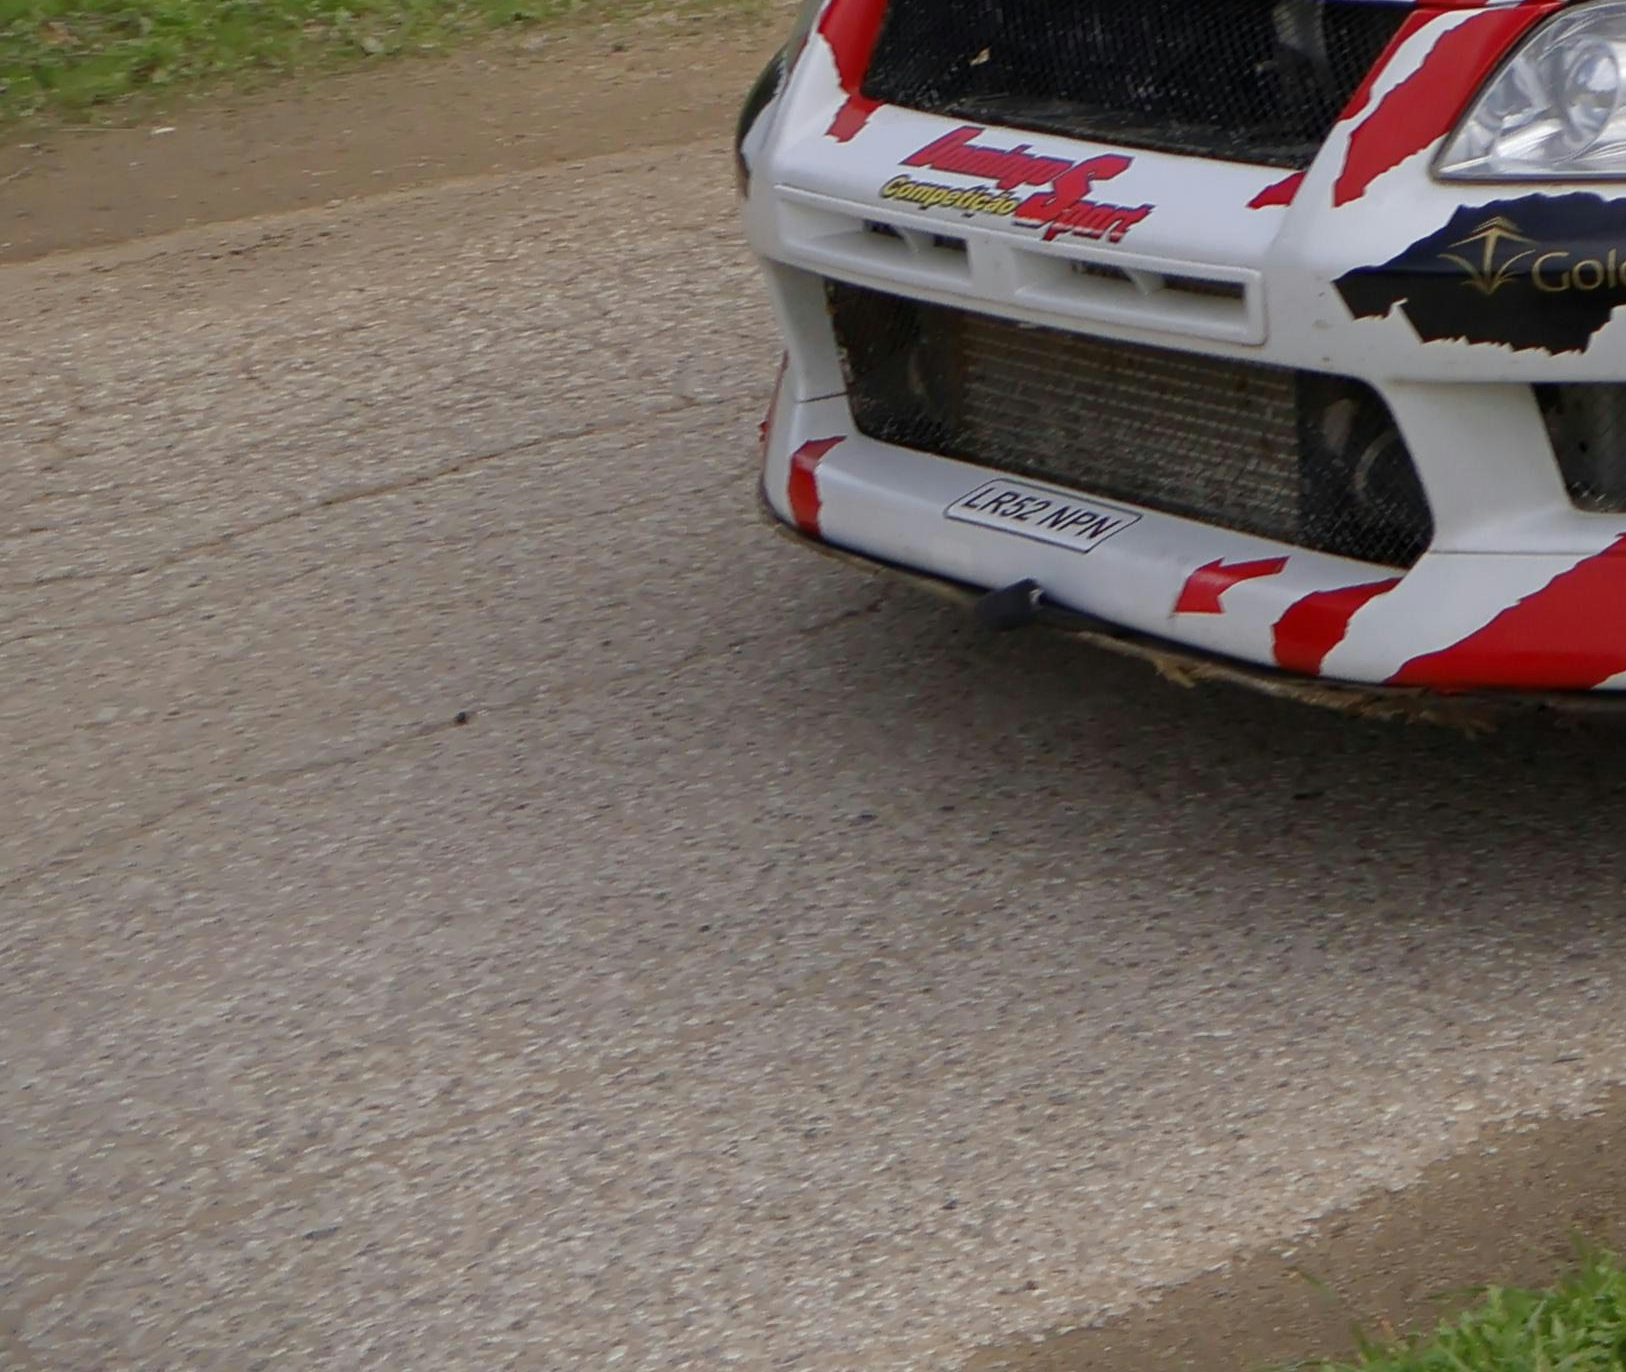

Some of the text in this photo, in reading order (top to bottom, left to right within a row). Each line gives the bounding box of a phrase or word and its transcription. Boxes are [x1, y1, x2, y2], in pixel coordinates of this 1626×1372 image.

[880, 153, 1157, 244] Competição Sport
[961, 487, 1122, 540] LR52 NPN
